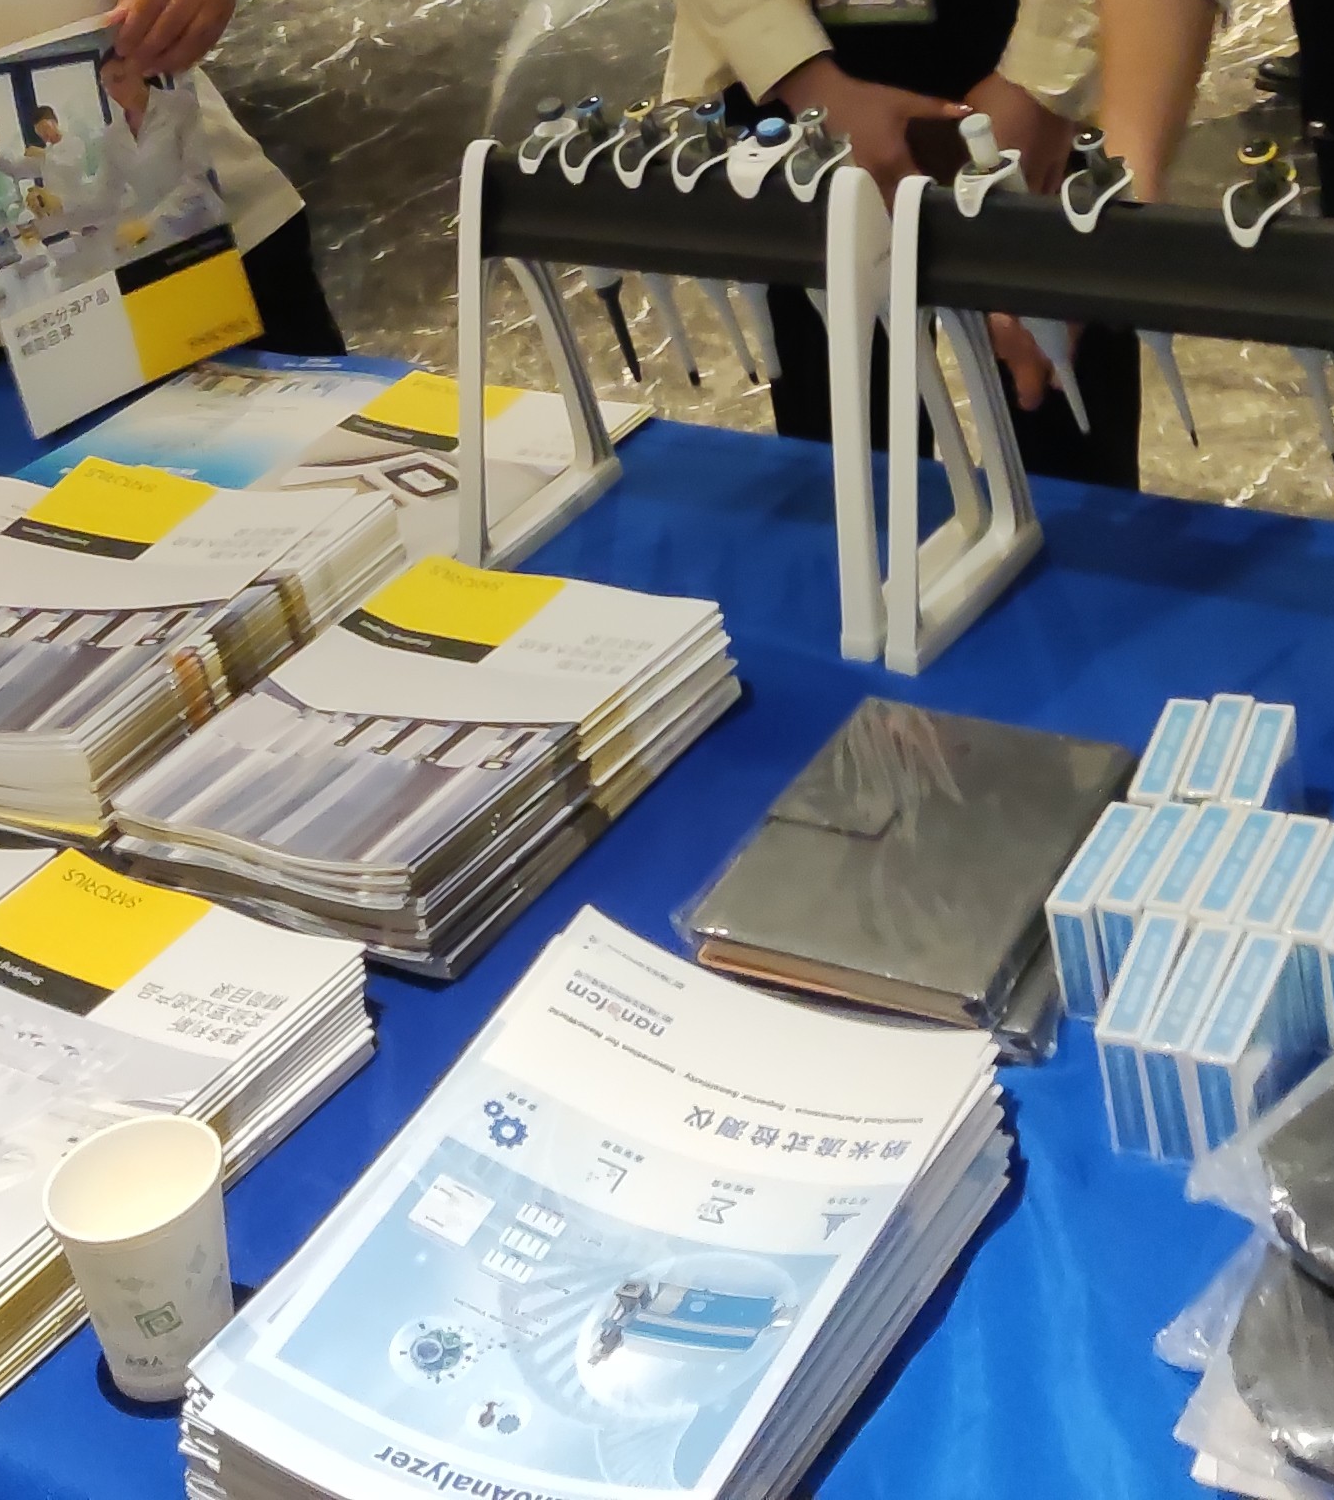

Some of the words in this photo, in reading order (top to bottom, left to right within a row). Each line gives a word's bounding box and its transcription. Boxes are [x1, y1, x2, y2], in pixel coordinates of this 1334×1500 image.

[683, 1104, 913, 1162] 纳米流式检测仪
